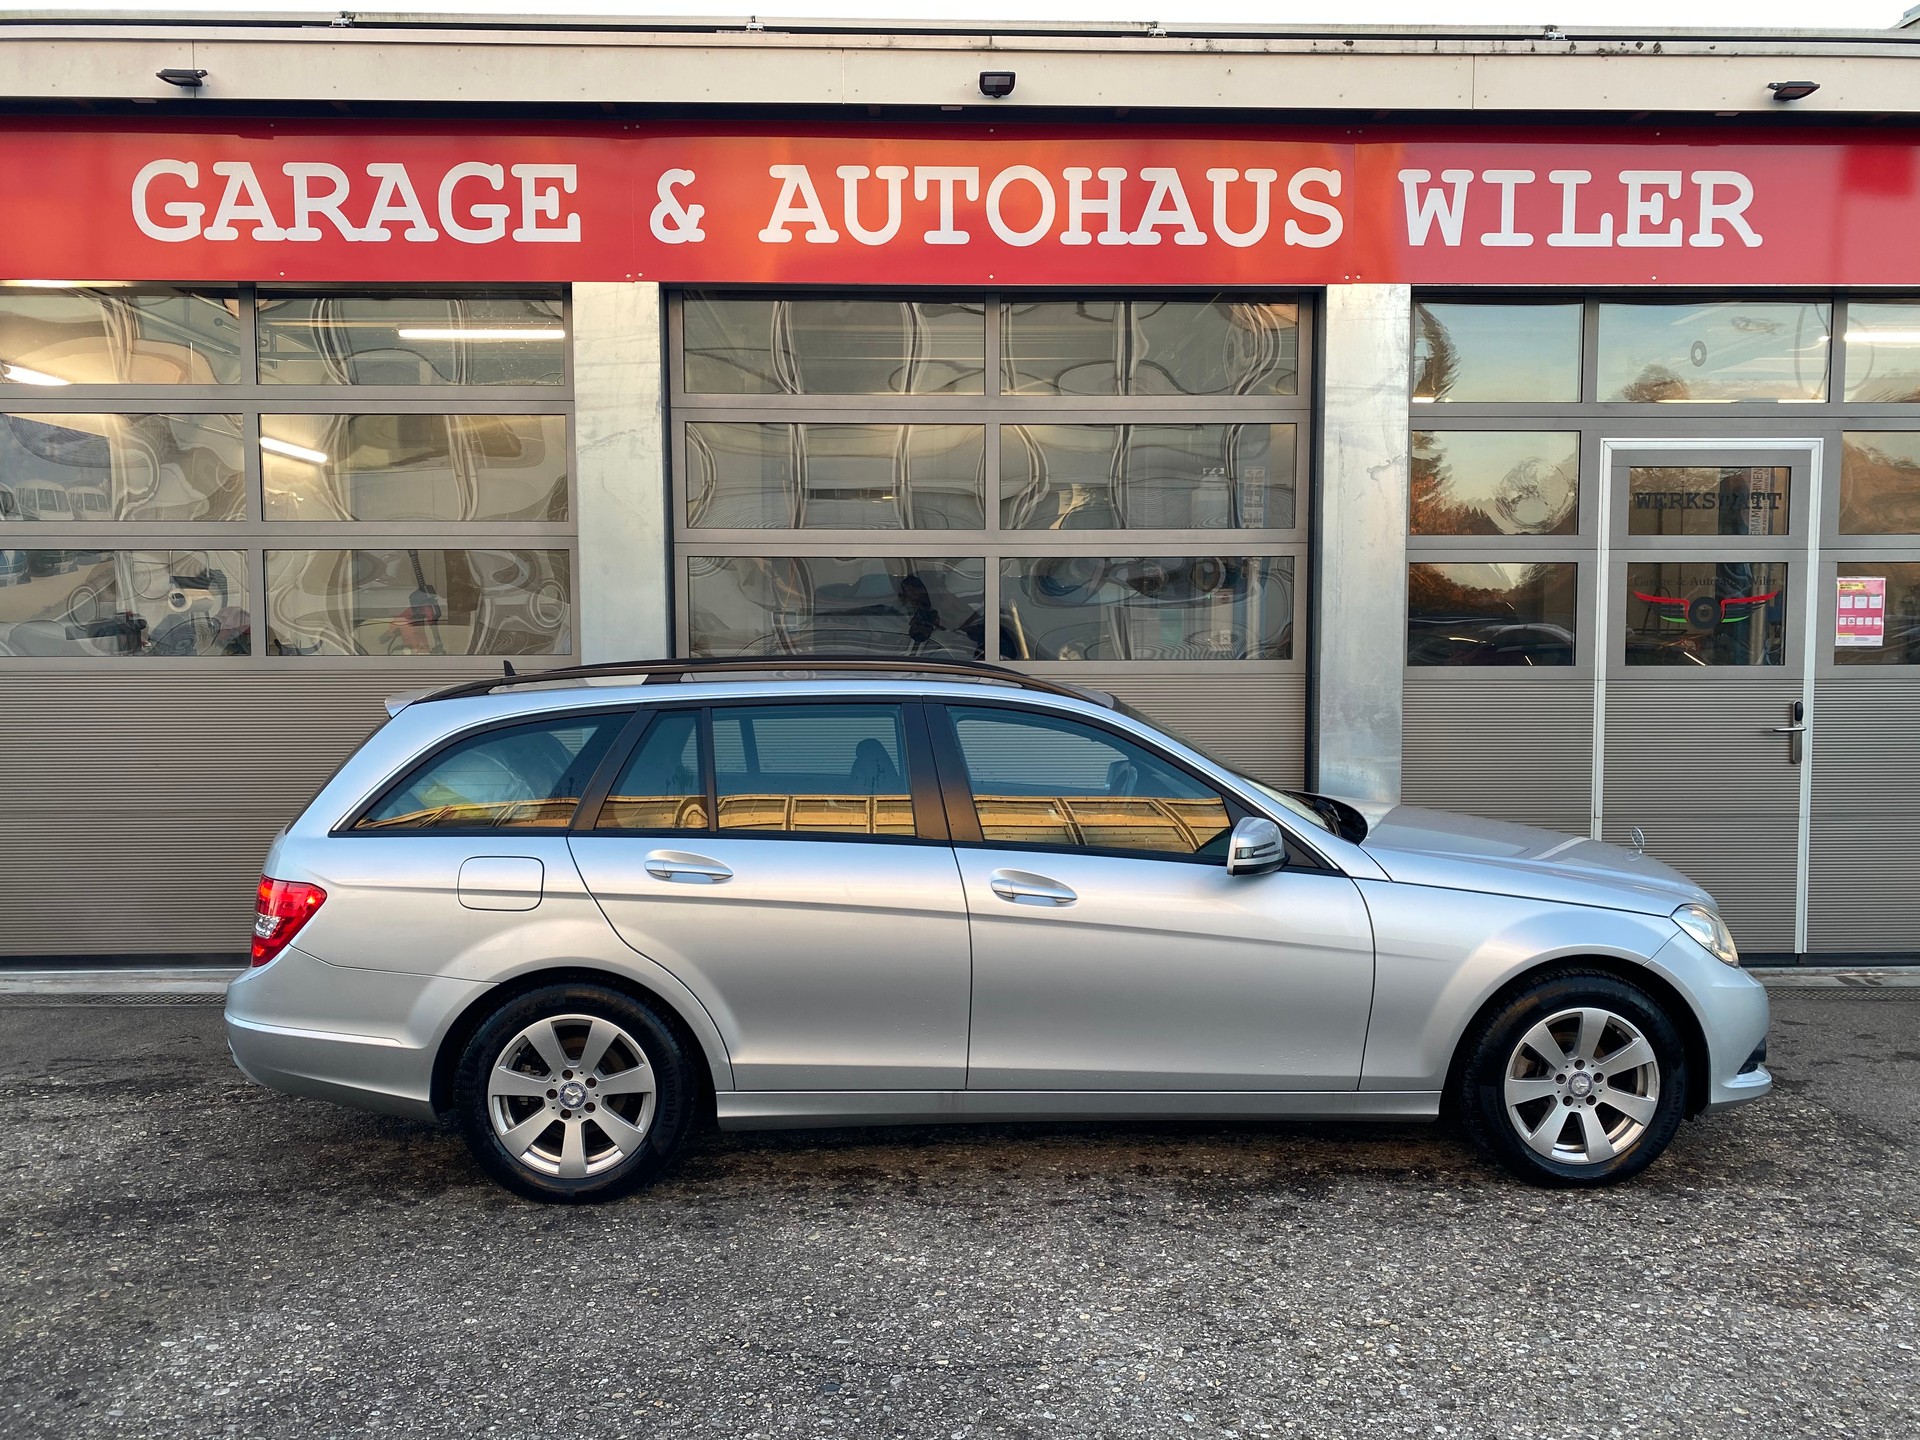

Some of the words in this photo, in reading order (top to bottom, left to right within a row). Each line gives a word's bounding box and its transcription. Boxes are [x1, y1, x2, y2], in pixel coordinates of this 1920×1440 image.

[132, 159, 582, 244] GARAGE
[650, 167, 706, 245] &
[759, 164, 1344, 249] AUTOHAUS
[1397, 168, 1764, 248] WILER
[1633, 491, 1782, 510] WERKSTATT
